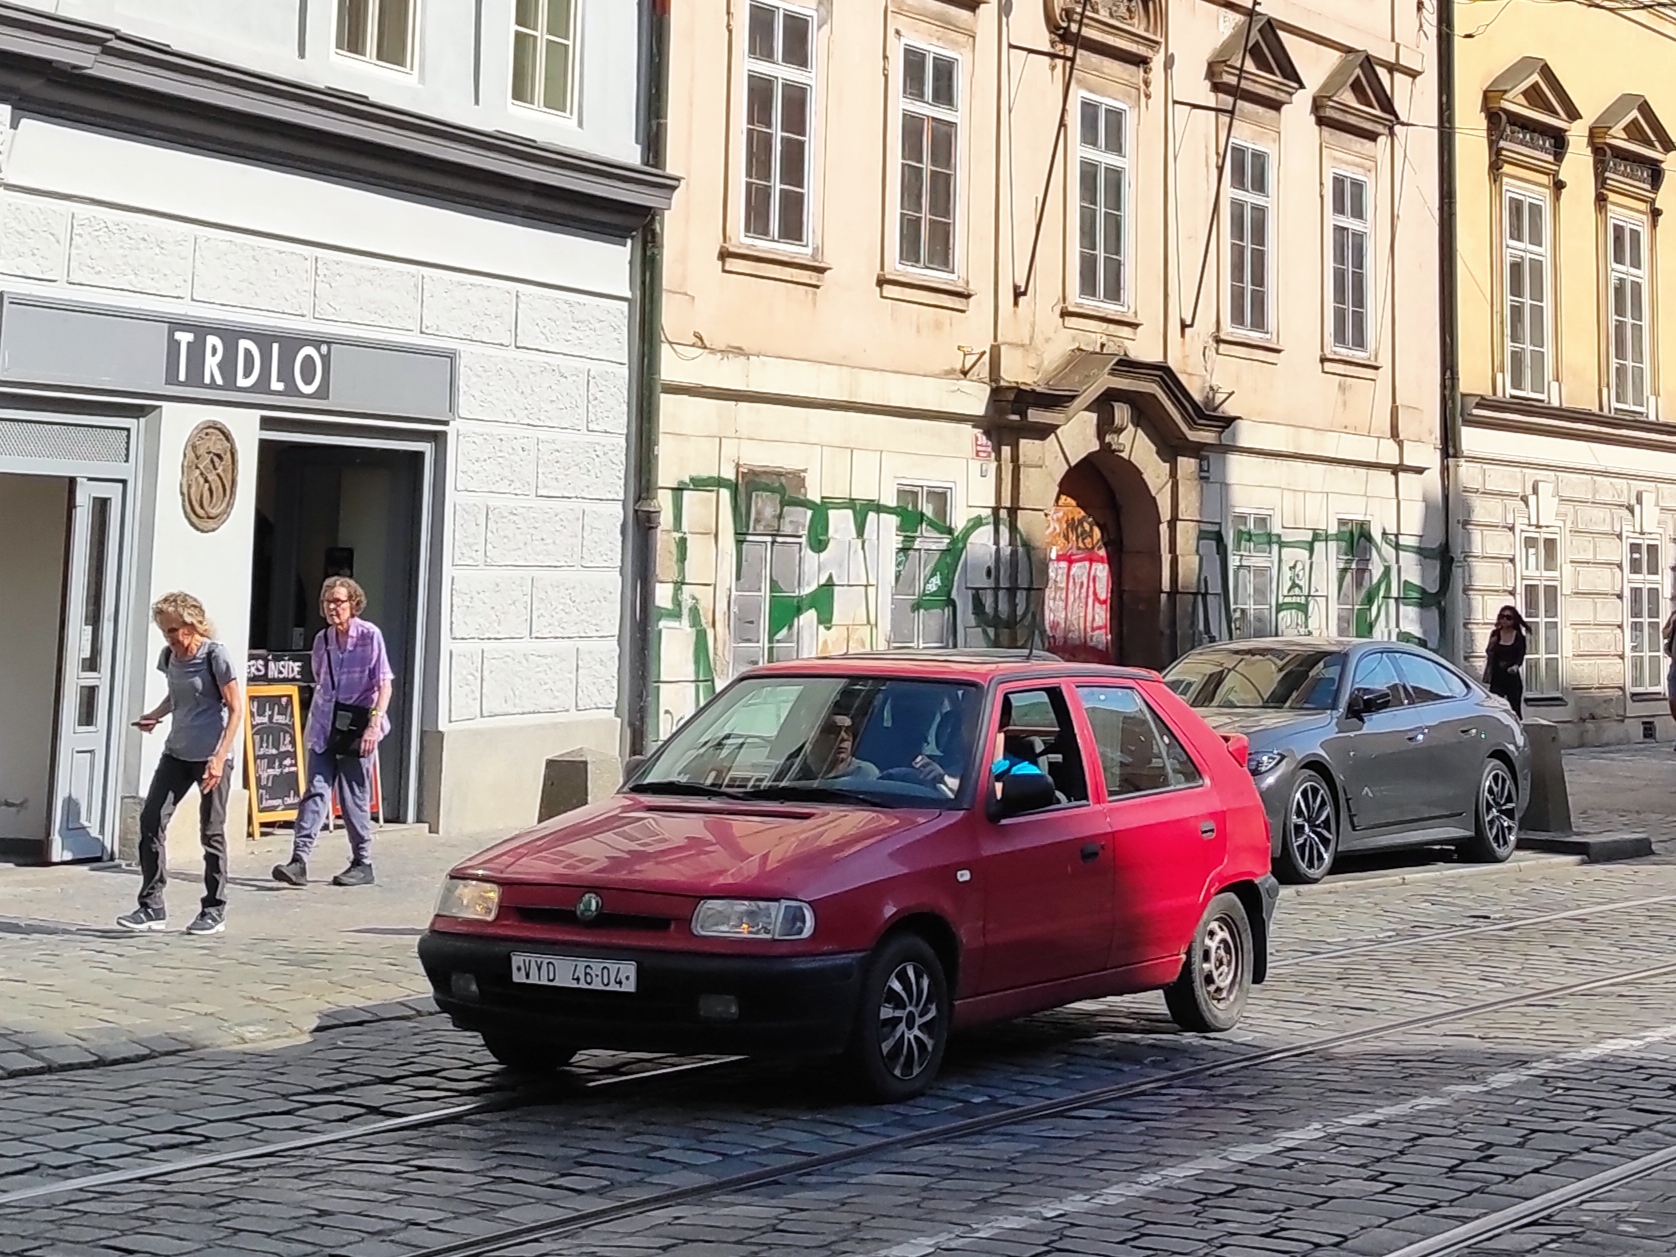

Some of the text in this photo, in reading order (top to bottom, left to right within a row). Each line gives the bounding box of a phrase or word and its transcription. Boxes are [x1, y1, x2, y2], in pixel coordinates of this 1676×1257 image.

[174, 331, 323, 394] TRDLO
[267, 657, 303, 679] INSIDE
[522, 958, 557, 983] VYD
